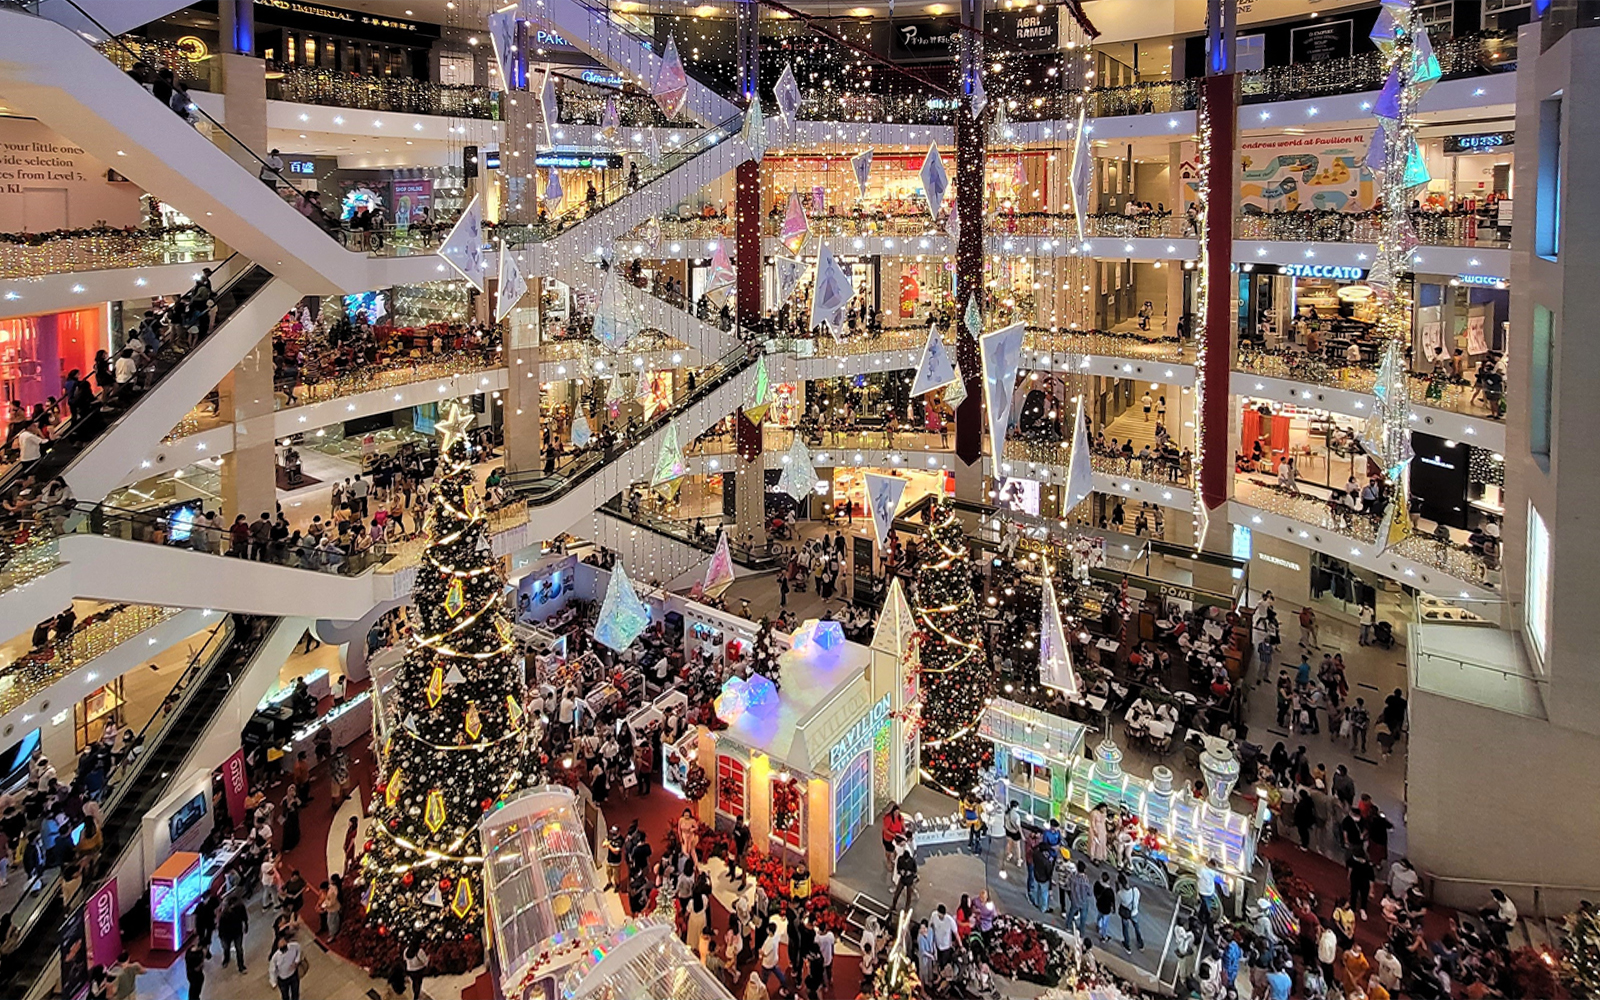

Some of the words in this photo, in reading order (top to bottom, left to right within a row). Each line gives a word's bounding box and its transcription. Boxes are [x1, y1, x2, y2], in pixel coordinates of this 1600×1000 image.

[291, 3, 355, 22] IMPERIAL
[1016, 25, 1052, 38] RAMEN
[1241, 142, 1276, 150] ondrous
[1277, 139, 1302, 147] world
[1315, 136, 1352, 145] Pavilion
[1354, 135, 1364, 143] KL
[1460, 135, 1503, 147] GUESS
[4, 143, 30, 152] your
[32, 142, 59, 153] little
[60, 146, 85, 155] ones
[25, 156, 73, 167] selection
[17, 169, 45, 180] from
[47, 171, 74, 181] Level
[7, 184, 23, 194] KL
[1286, 264, 1362, 279] STACCATO
[829, 691, 891, 767] PAVILION
